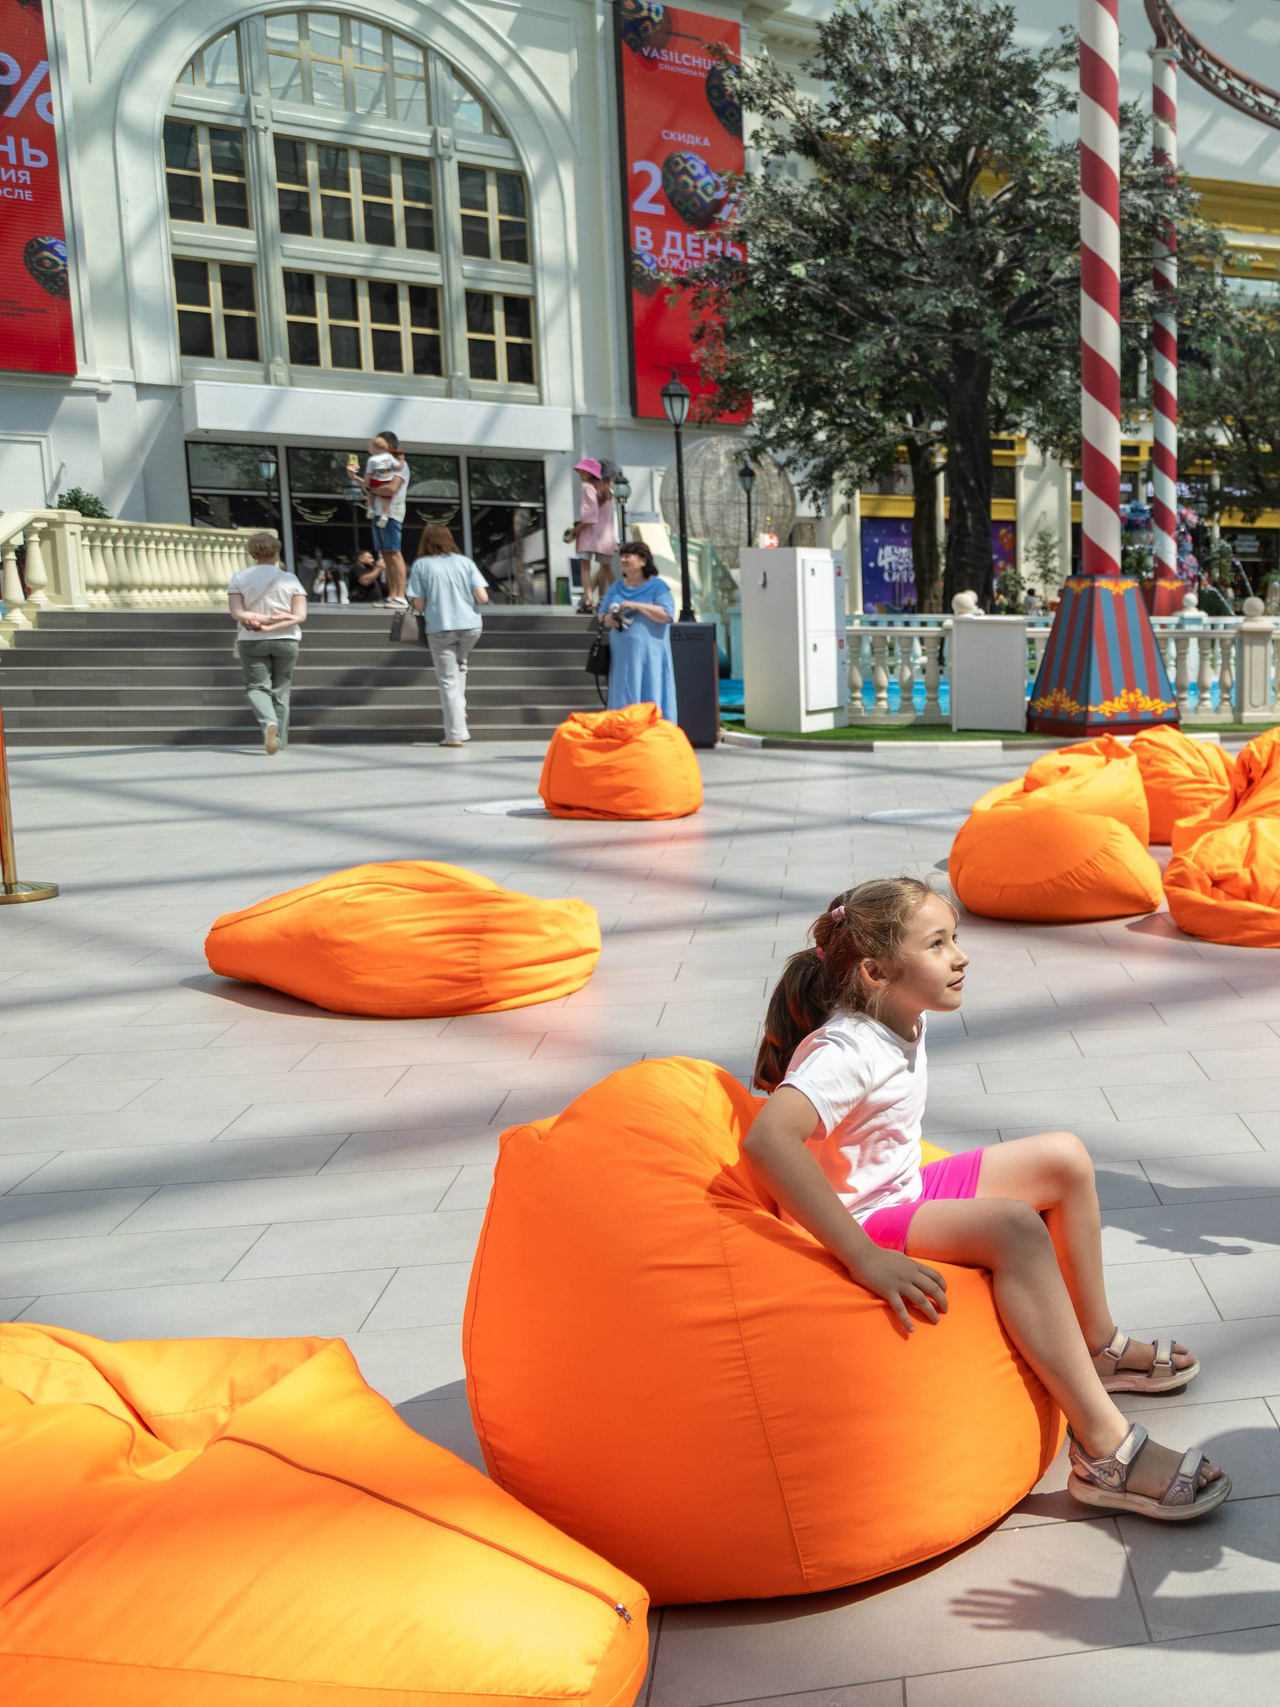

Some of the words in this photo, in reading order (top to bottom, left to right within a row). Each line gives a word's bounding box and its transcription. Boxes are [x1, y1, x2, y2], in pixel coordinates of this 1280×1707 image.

[661, 129, 711, 147] СКИДКА
[635, 226, 654, 251] В
[662, 230, 743, 261] ДЕНЬ
